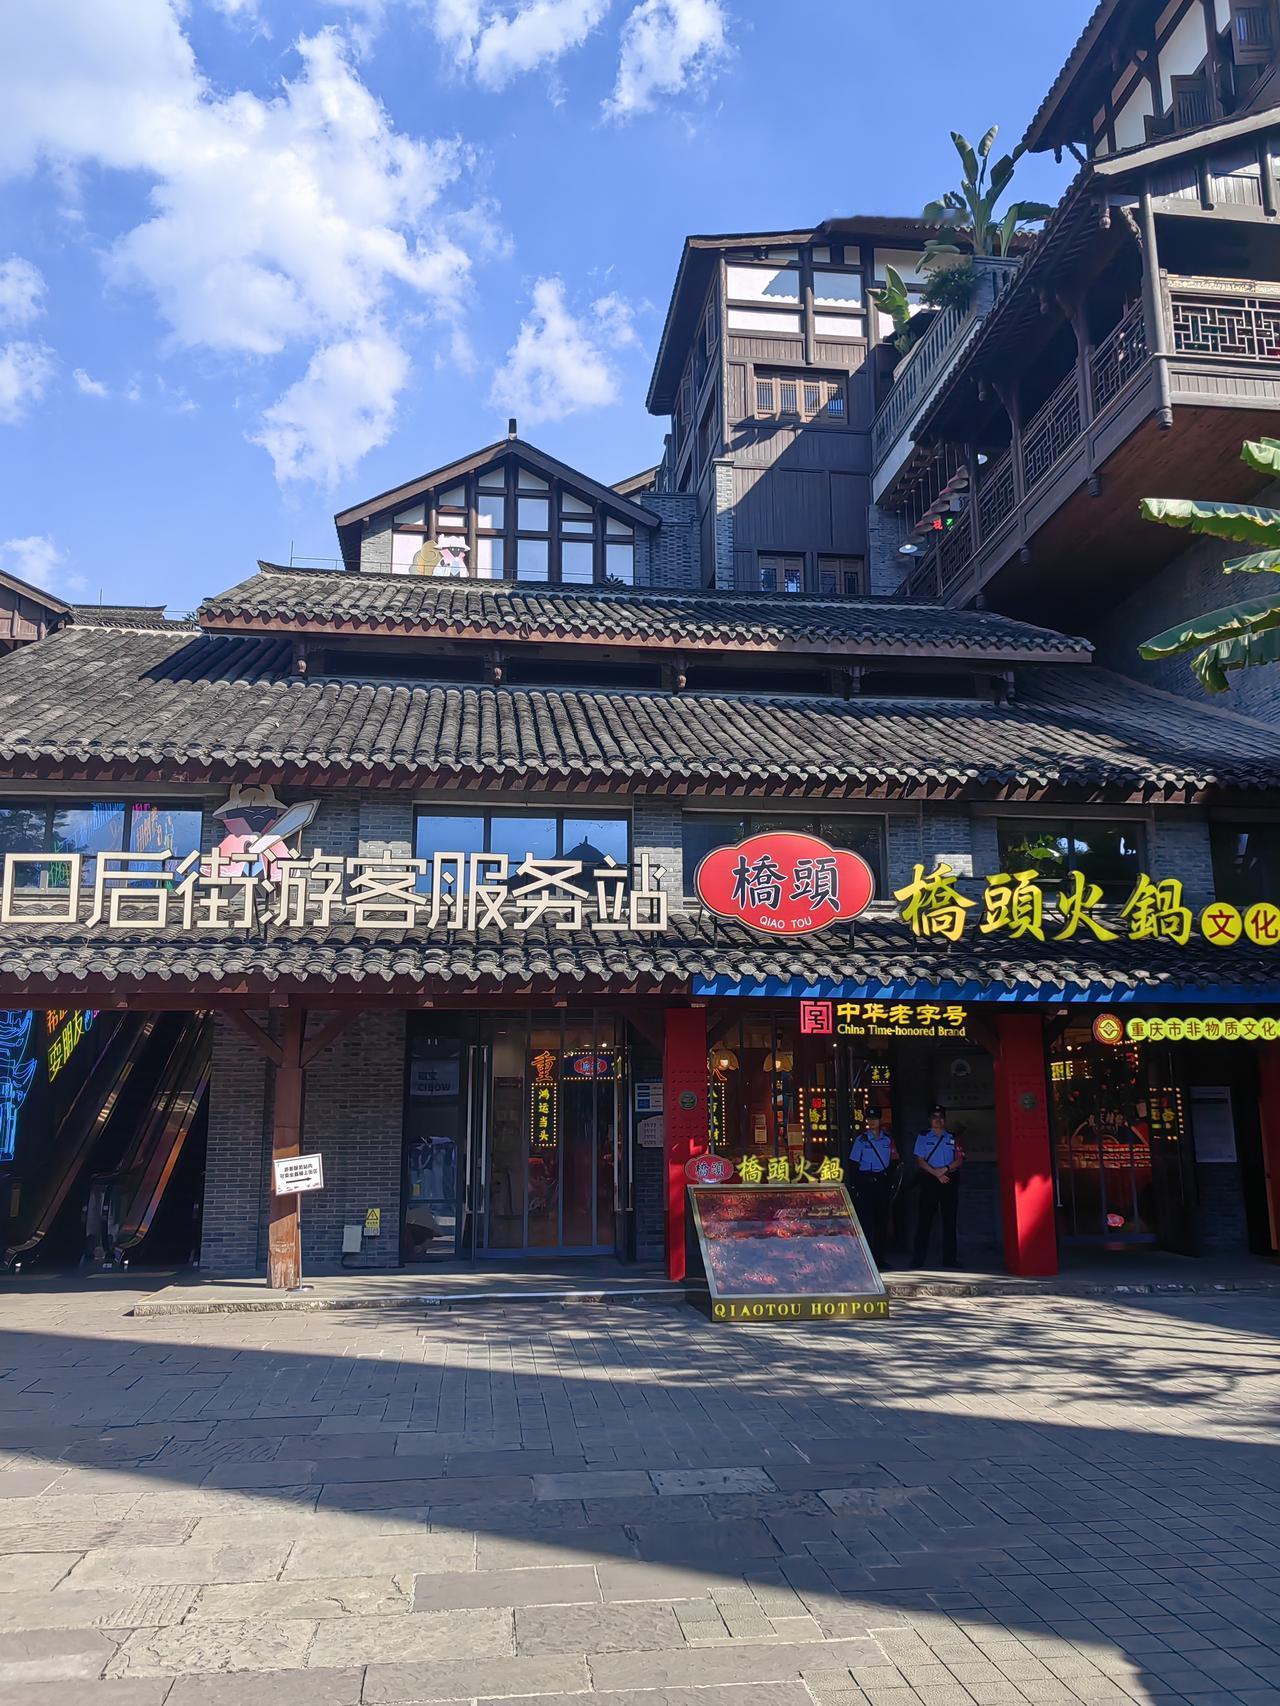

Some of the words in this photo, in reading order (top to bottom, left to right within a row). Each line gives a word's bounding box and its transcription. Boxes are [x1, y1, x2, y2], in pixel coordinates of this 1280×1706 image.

[1, 848, 667, 931] 口后街游客服务站
[731, 854, 840, 912] 橋頭
[894, 863, 1192, 945] 橋頭火鍋
[759, 915, 786, 929] QIAO
[791, 915, 812, 928] TOU
[837, 1003, 967, 1025] 中华老字号
[837, 1024, 865, 1036] China
[869, 1024, 935, 1036] Time-honored
[938, 1025, 966, 1037] Brand
[1129, 1019, 1277, 1039] 重庆市非物质文化
[538, 1088, 550, 1141] 鸿运当头
[736, 1154, 844, 1183] 橋頭火鍋
[713, 1303, 801, 1318] QIAOTOU
[811, 1302, 887, 1315] HOTPOT
